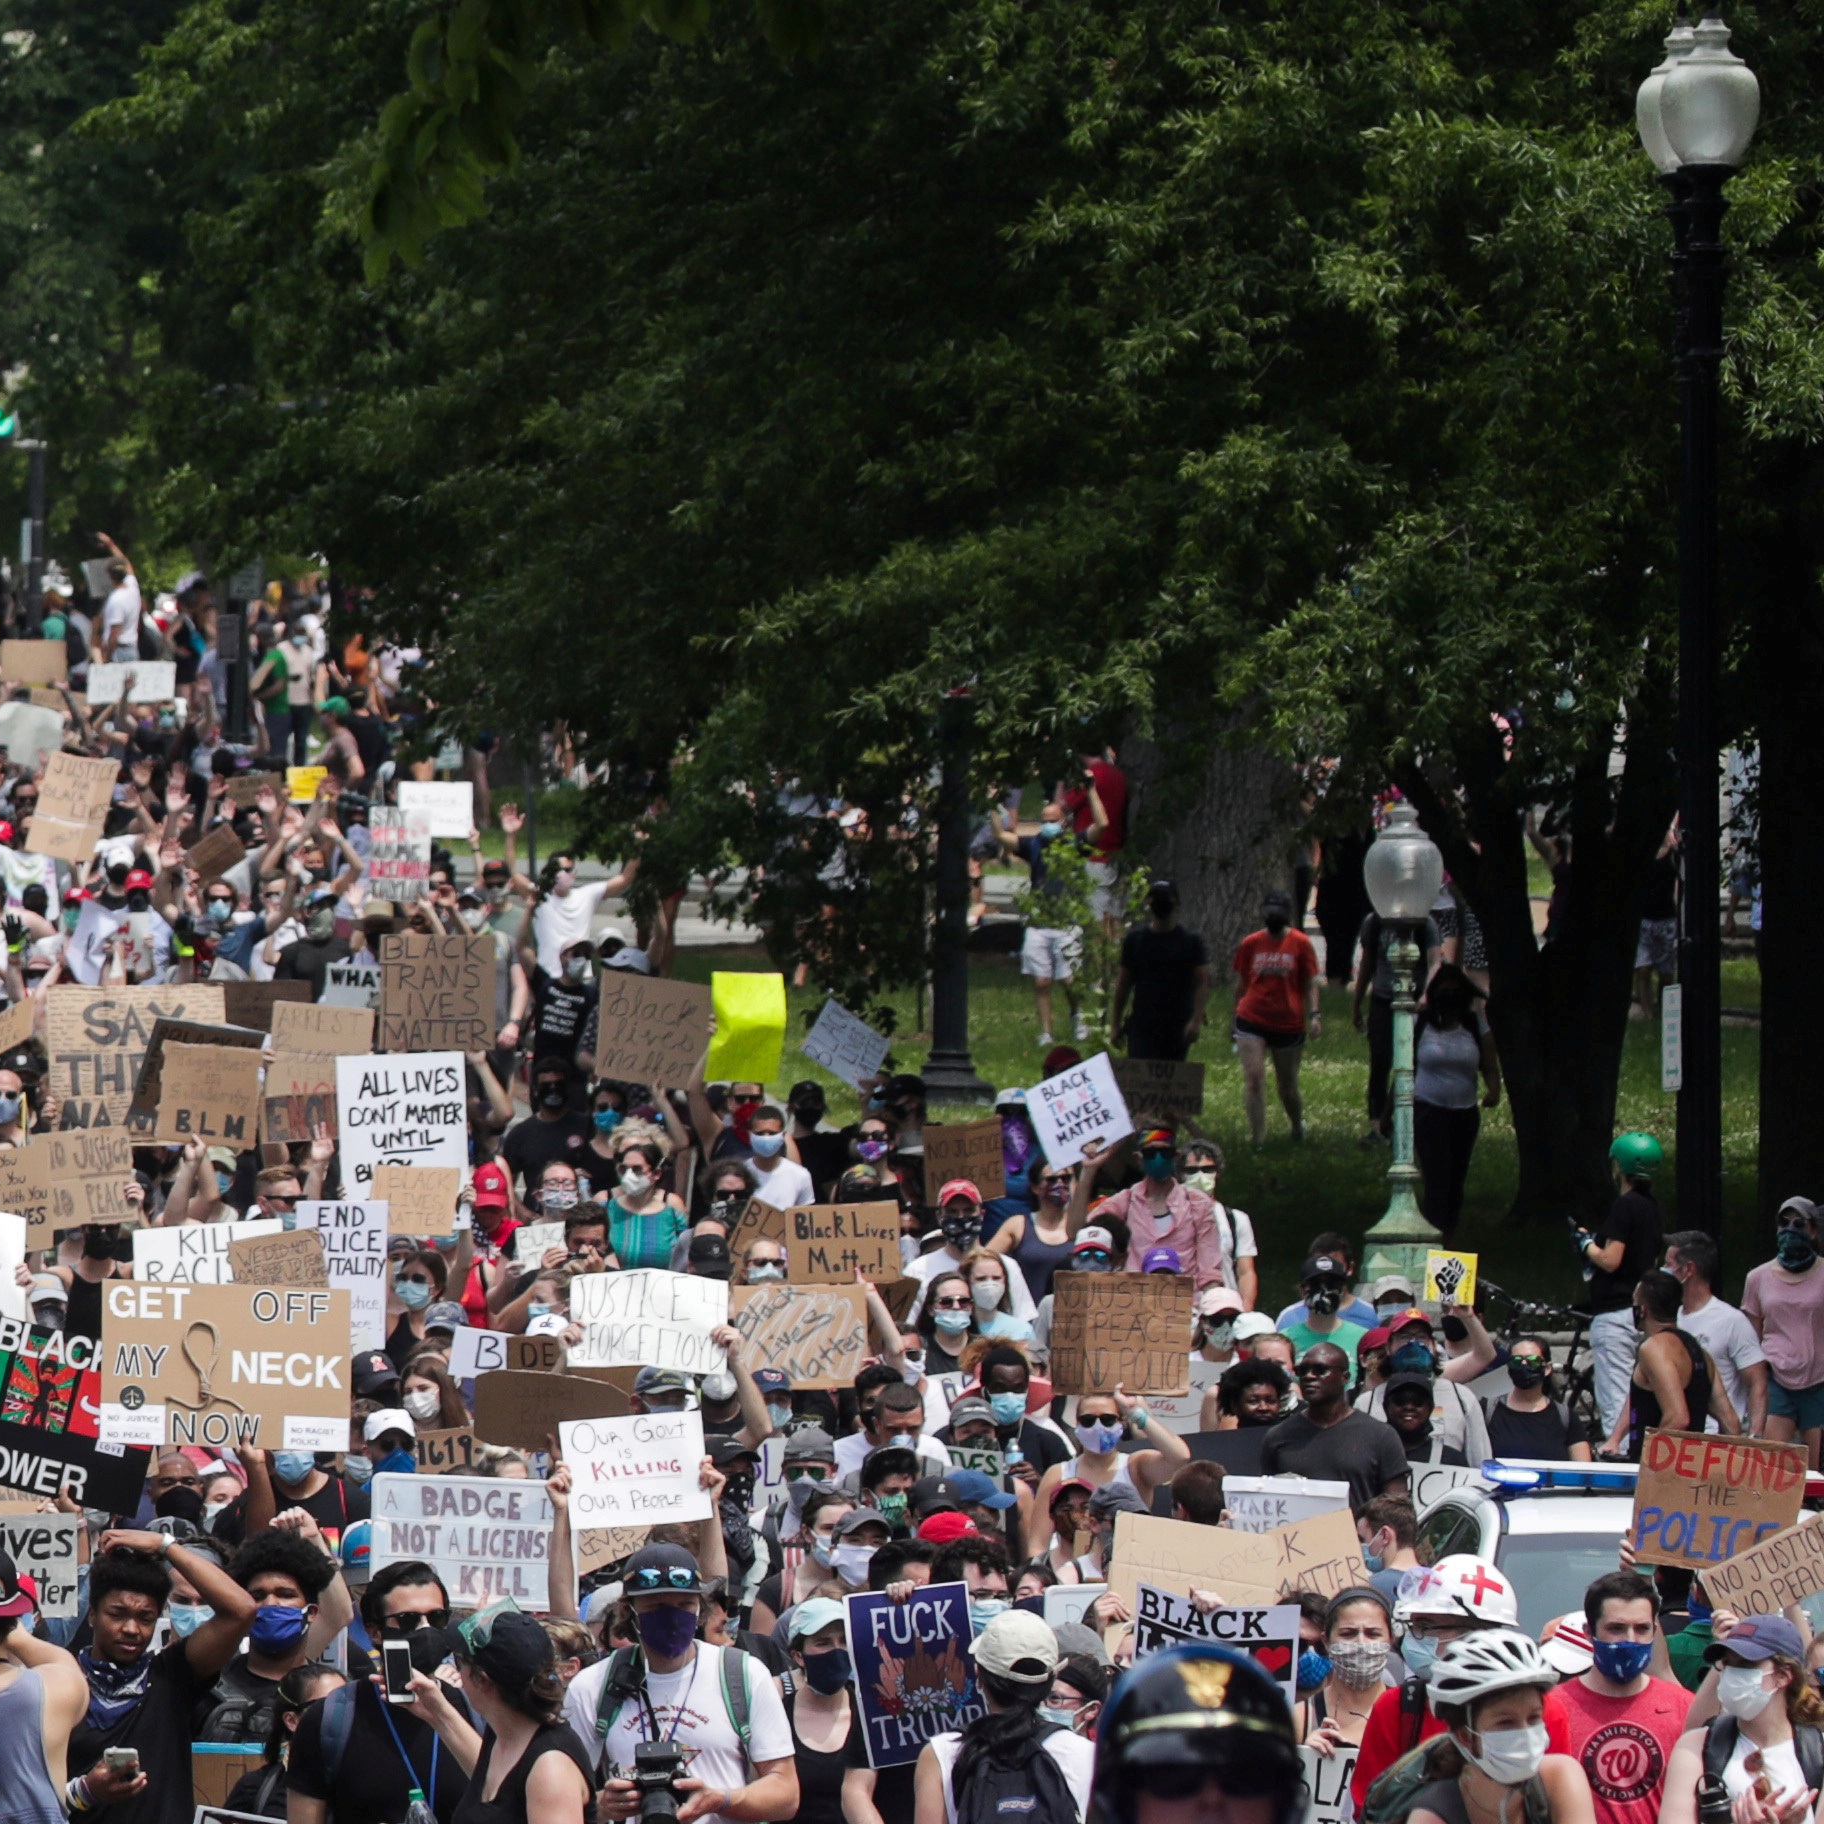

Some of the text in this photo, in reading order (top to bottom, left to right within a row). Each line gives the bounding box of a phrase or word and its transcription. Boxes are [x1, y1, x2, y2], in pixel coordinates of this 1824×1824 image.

[359, 1068, 460, 1099] ALL LIVES
[1042, 1070, 1092, 1101] BLACK
[405, 1101, 463, 1125] MATTER
[1055, 1110, 1115, 1146] MATTER
[1056, 1097, 1102, 1128] LIVES
[372, 1128, 445, 1149] UNTIL
[794, 1210, 896, 1242] Black Lives
[808, 1246, 884, 1275] Matter!
[108, 1286, 330, 1324] GET OFF
[575, 1273, 692, 1321] JUSTICE
[114, 1344, 342, 1389] MY NECK
[108, 1414, 161, 1424] NO JUSTICE
[170, 1412, 260, 1446] NOW
[290, 1427, 336, 1436] NO RACIST
[98, 1443, 125, 1454] LOVE
[107, 1431, 152, 1439] NO PEACE
[290, 1438, 320, 1446] POLICE
[617, 1448, 632, 1459] IS
[1650, 1433, 1802, 1492] DEFUND
[591, 1459, 683, 1482] KILLING
[384, 1487, 522, 1520] A BADGE
[578, 1491, 683, 1513] OUR PEOPLE
[1691, 1485, 1737, 1506] THE
[392, 1523, 552, 1558] NOT A LICENS
[461, 1566, 529, 1597] KILL
[871, 1600, 953, 1646] FUCK
[1141, 1589, 1268, 1638] BLACK
[1586, 1725, 1659, 1758] WASHINGTON
[1591, 1774, 1657, 1801] NATIONALS
